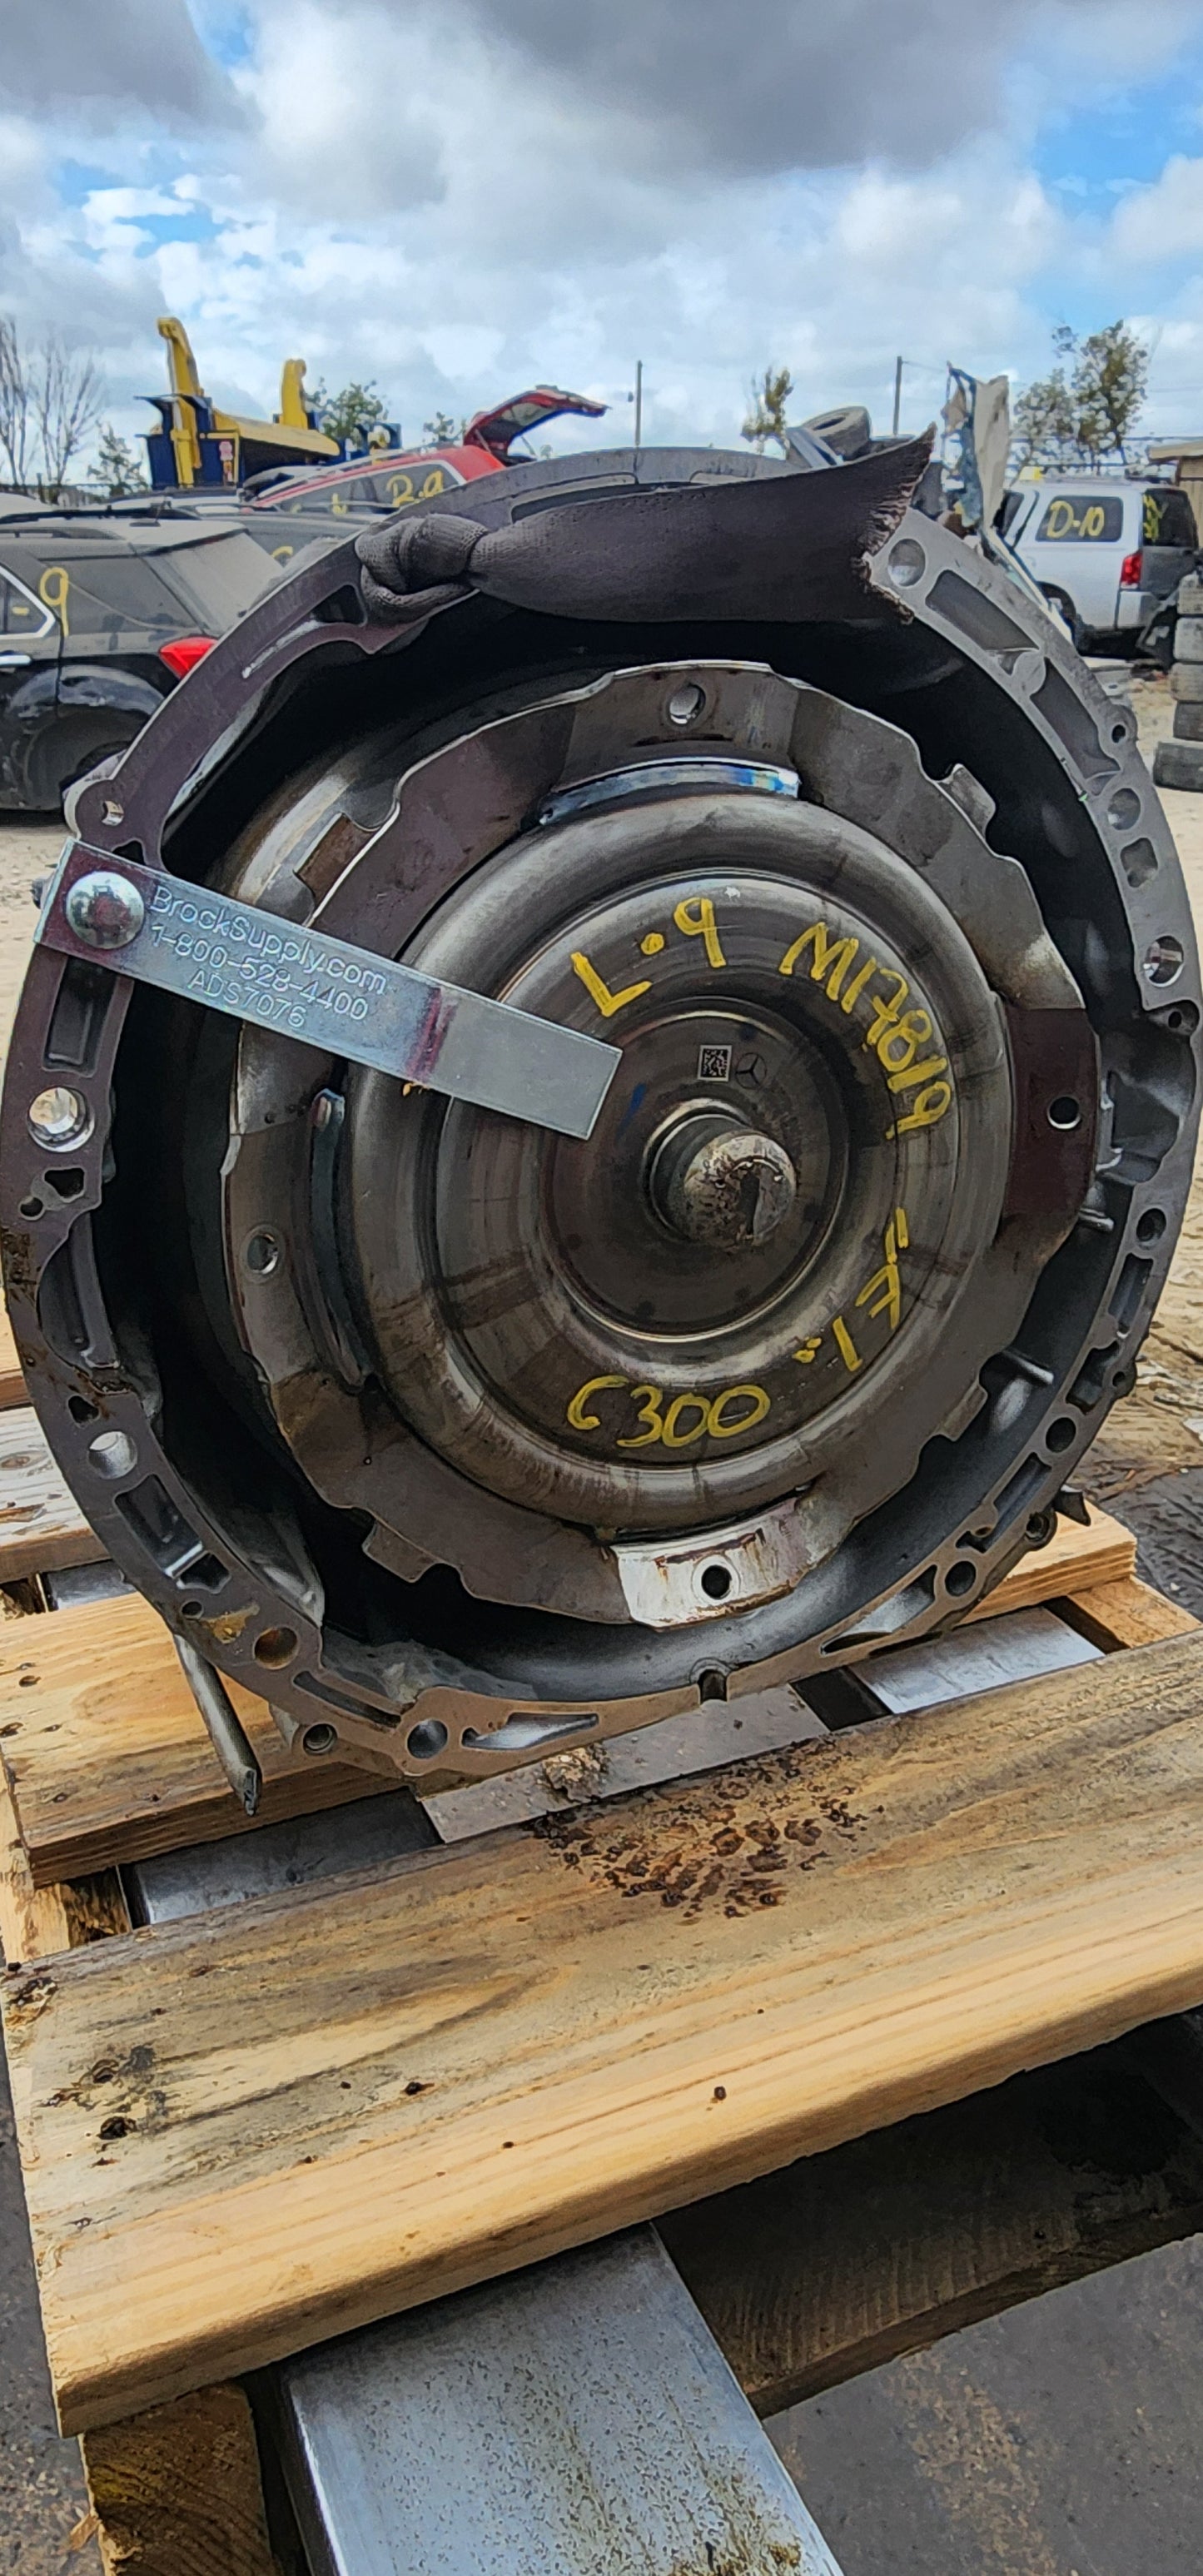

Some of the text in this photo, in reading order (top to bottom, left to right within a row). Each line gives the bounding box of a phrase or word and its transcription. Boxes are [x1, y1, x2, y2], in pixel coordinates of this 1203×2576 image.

[150, 885, 386, 995] BrockSupply.com
[152, 922, 369, 1021] 1-800-528-4400
[188, 969, 307, 1028] ADS7076
[779, 922, 952, 1140] M17819
